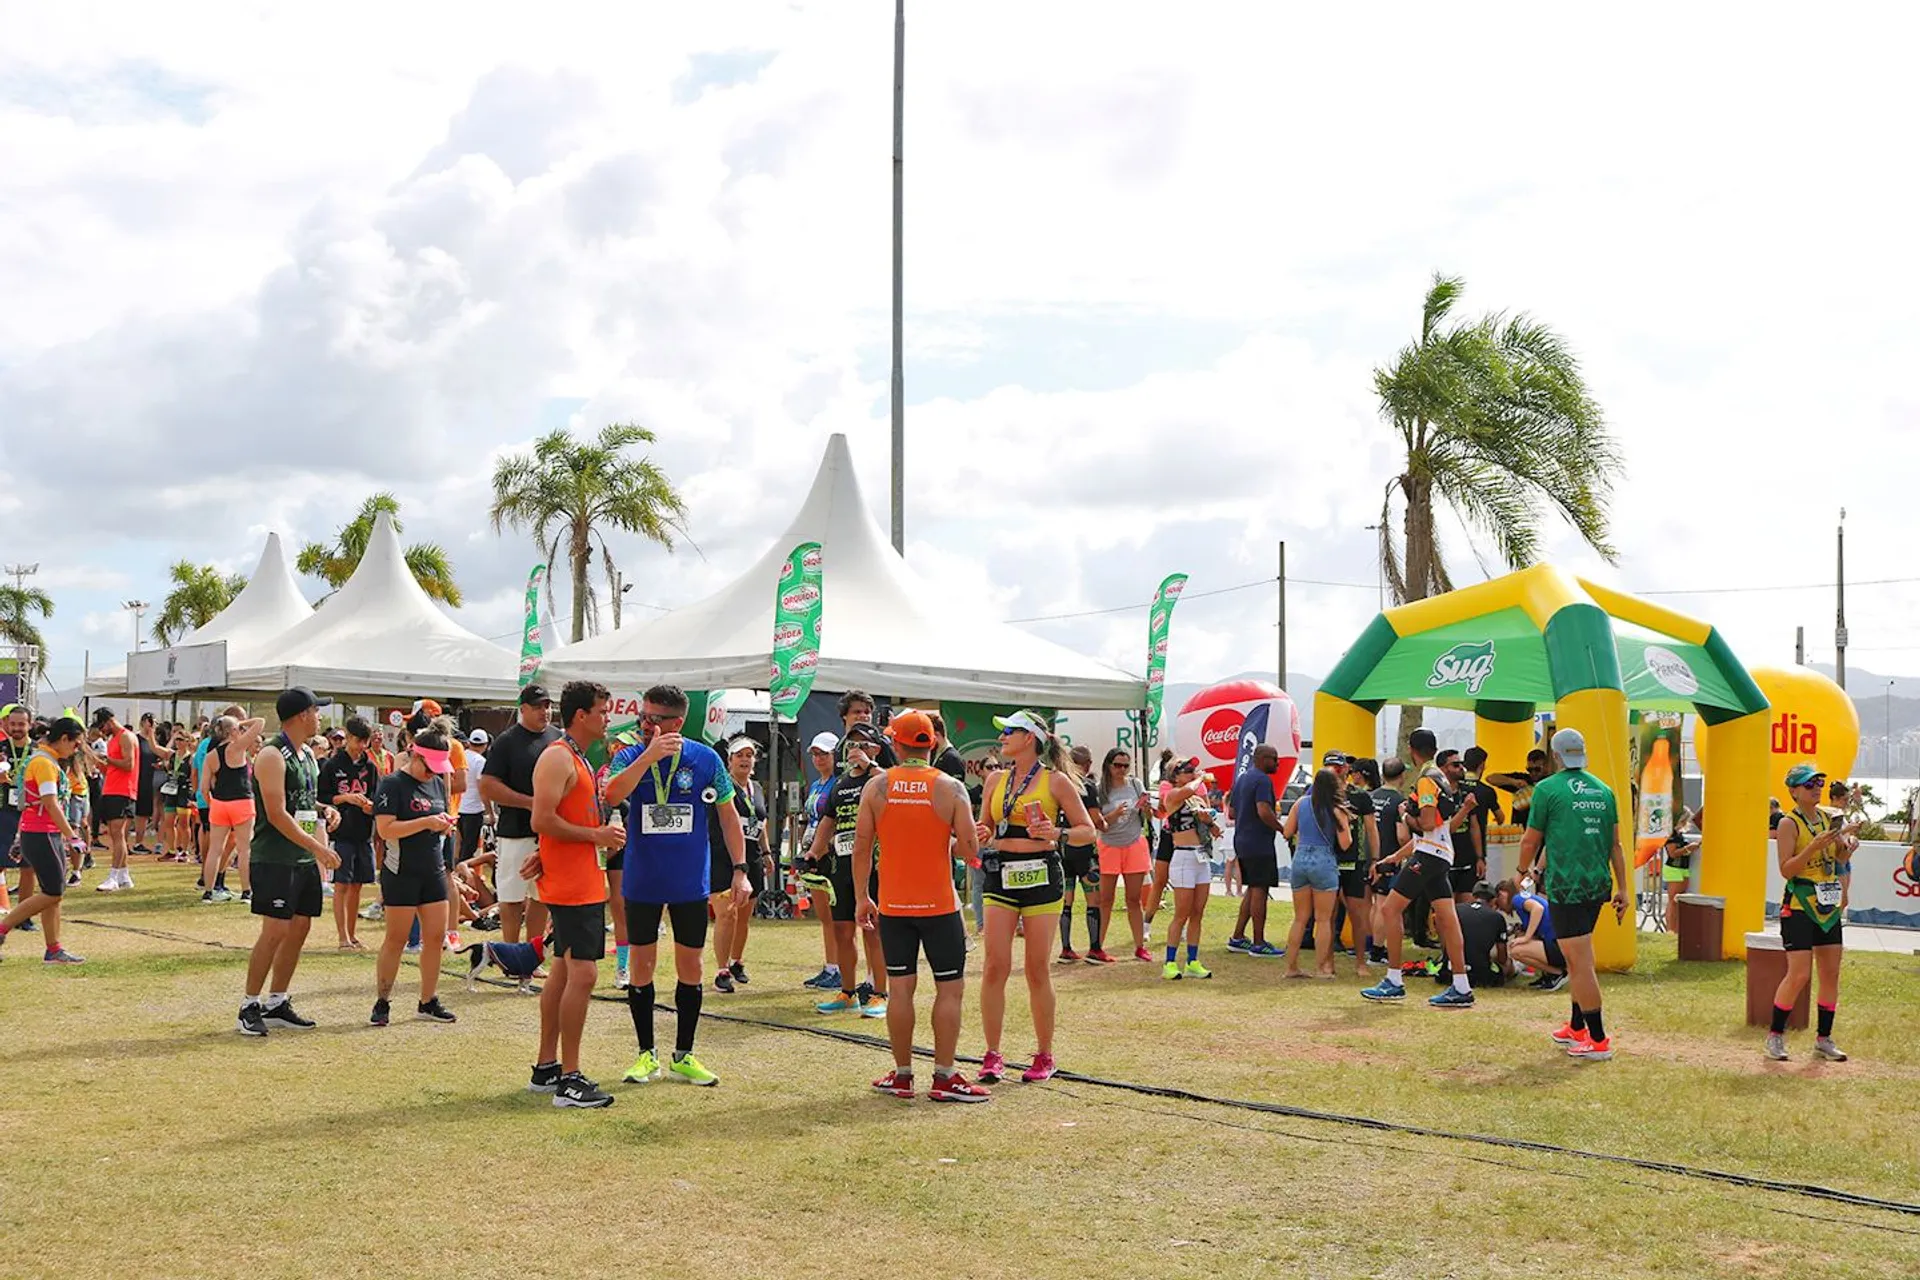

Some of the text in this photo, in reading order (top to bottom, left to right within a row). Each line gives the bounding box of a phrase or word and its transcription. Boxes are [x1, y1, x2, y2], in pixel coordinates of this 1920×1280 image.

[783, 592, 818, 606] ORQUIDEA
[1771, 713, 1817, 755] dia
[892, 780, 928, 794] ATLETA
[1012, 869, 1041, 883] 1857
[564, 1086, 583, 1100] FILA
